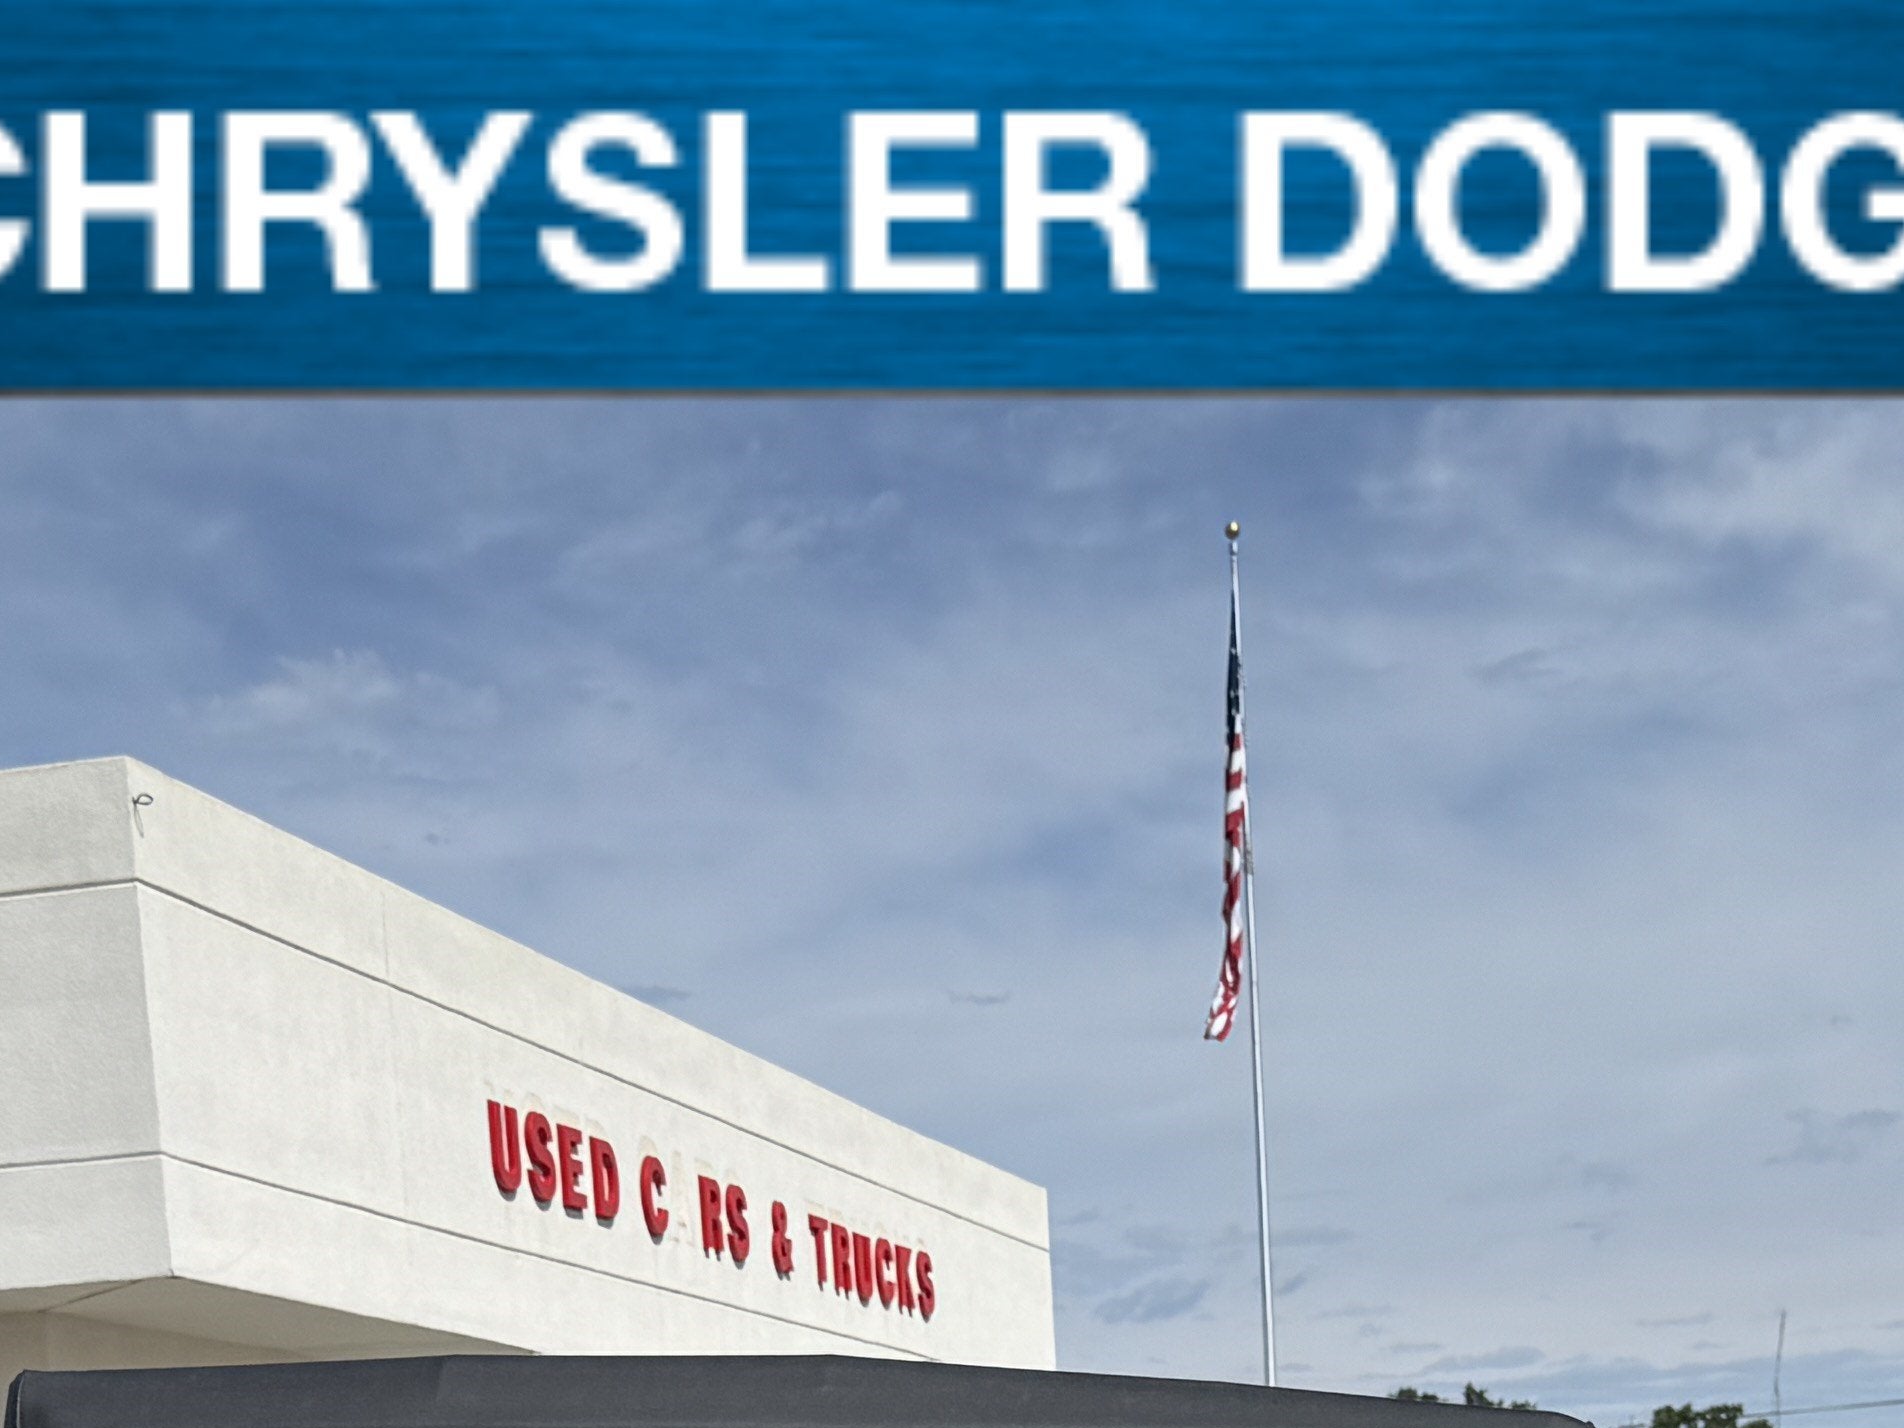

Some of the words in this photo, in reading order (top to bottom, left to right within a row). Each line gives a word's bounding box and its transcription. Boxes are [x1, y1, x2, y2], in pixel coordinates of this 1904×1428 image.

[487, 1099, 620, 1221] USED
[771, 1200, 794, 1275] &
[808, 1214, 936, 1320] TRUCKS
